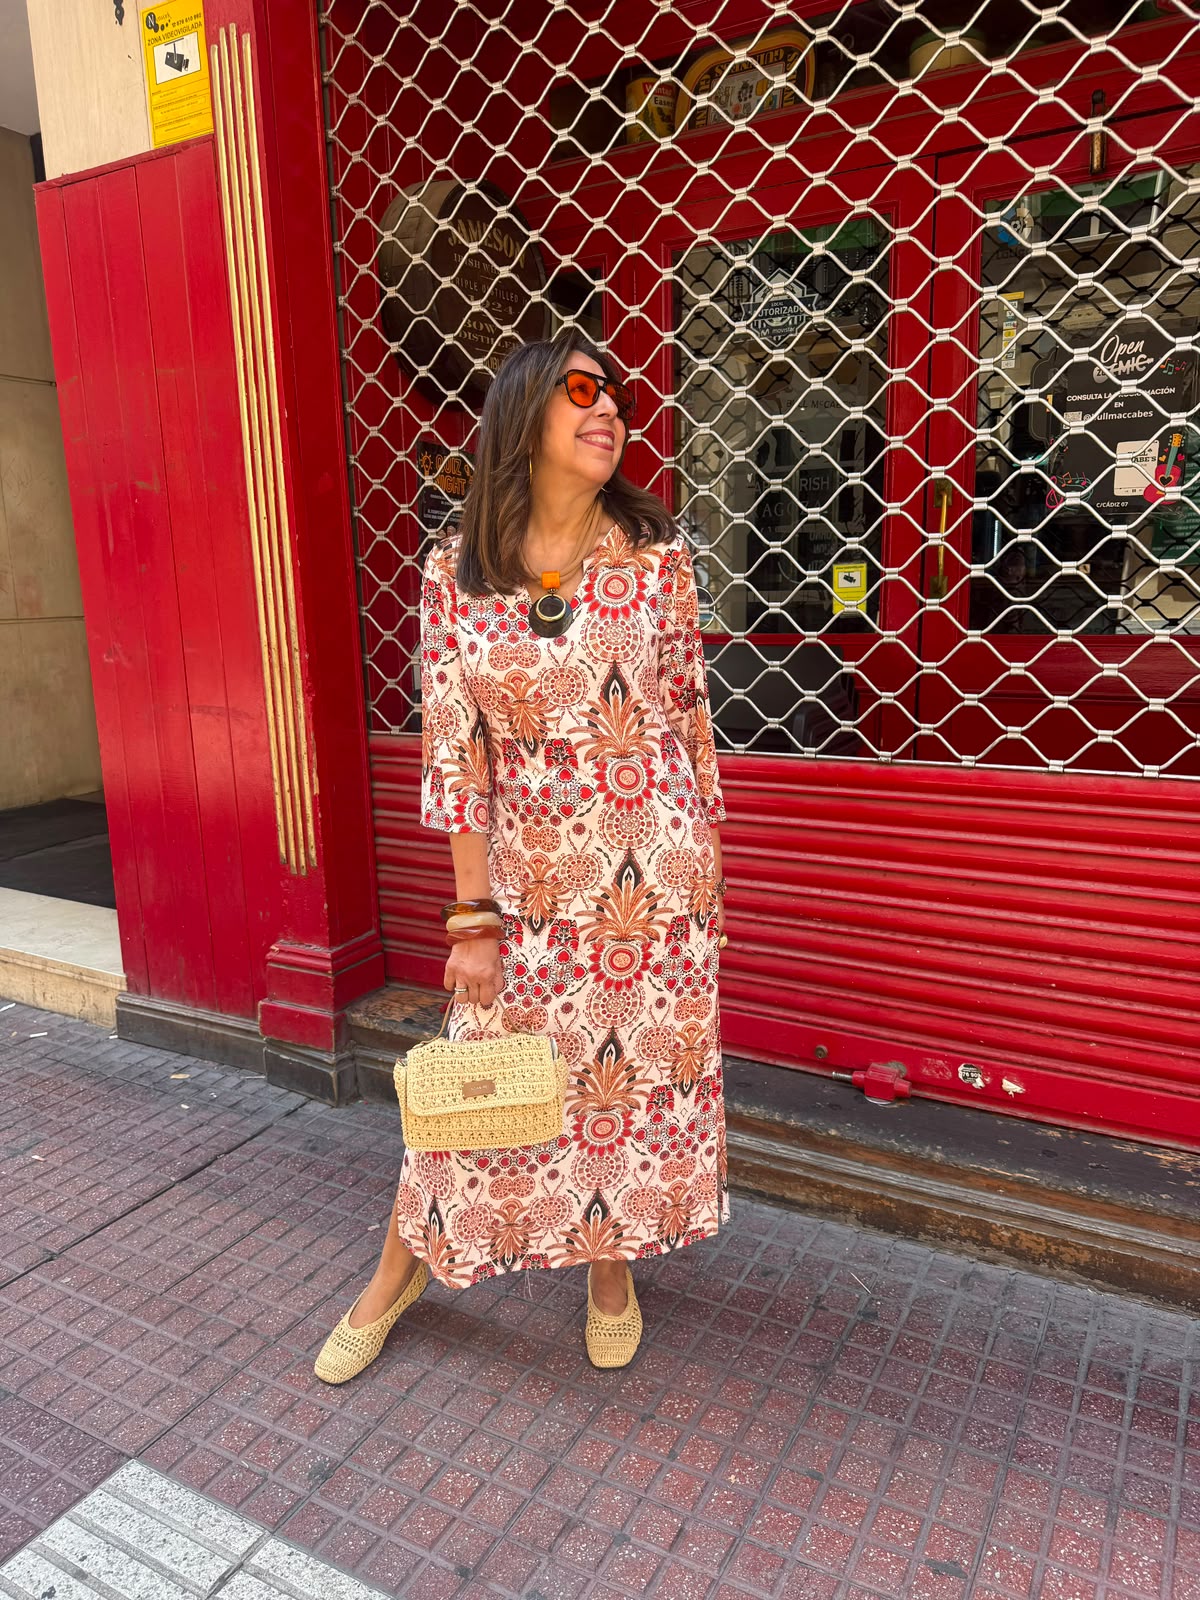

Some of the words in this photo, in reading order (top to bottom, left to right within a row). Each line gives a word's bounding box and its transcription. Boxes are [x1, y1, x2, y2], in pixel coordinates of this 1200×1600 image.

[147, 35, 162, 47] ZONA
[453, 276, 478, 291] RIPLE
[1101, 334, 1145, 363] Open
[1066, 393, 1103, 402] CONSULTA
[1083, 410, 1154, 421] @ullmaccabes
